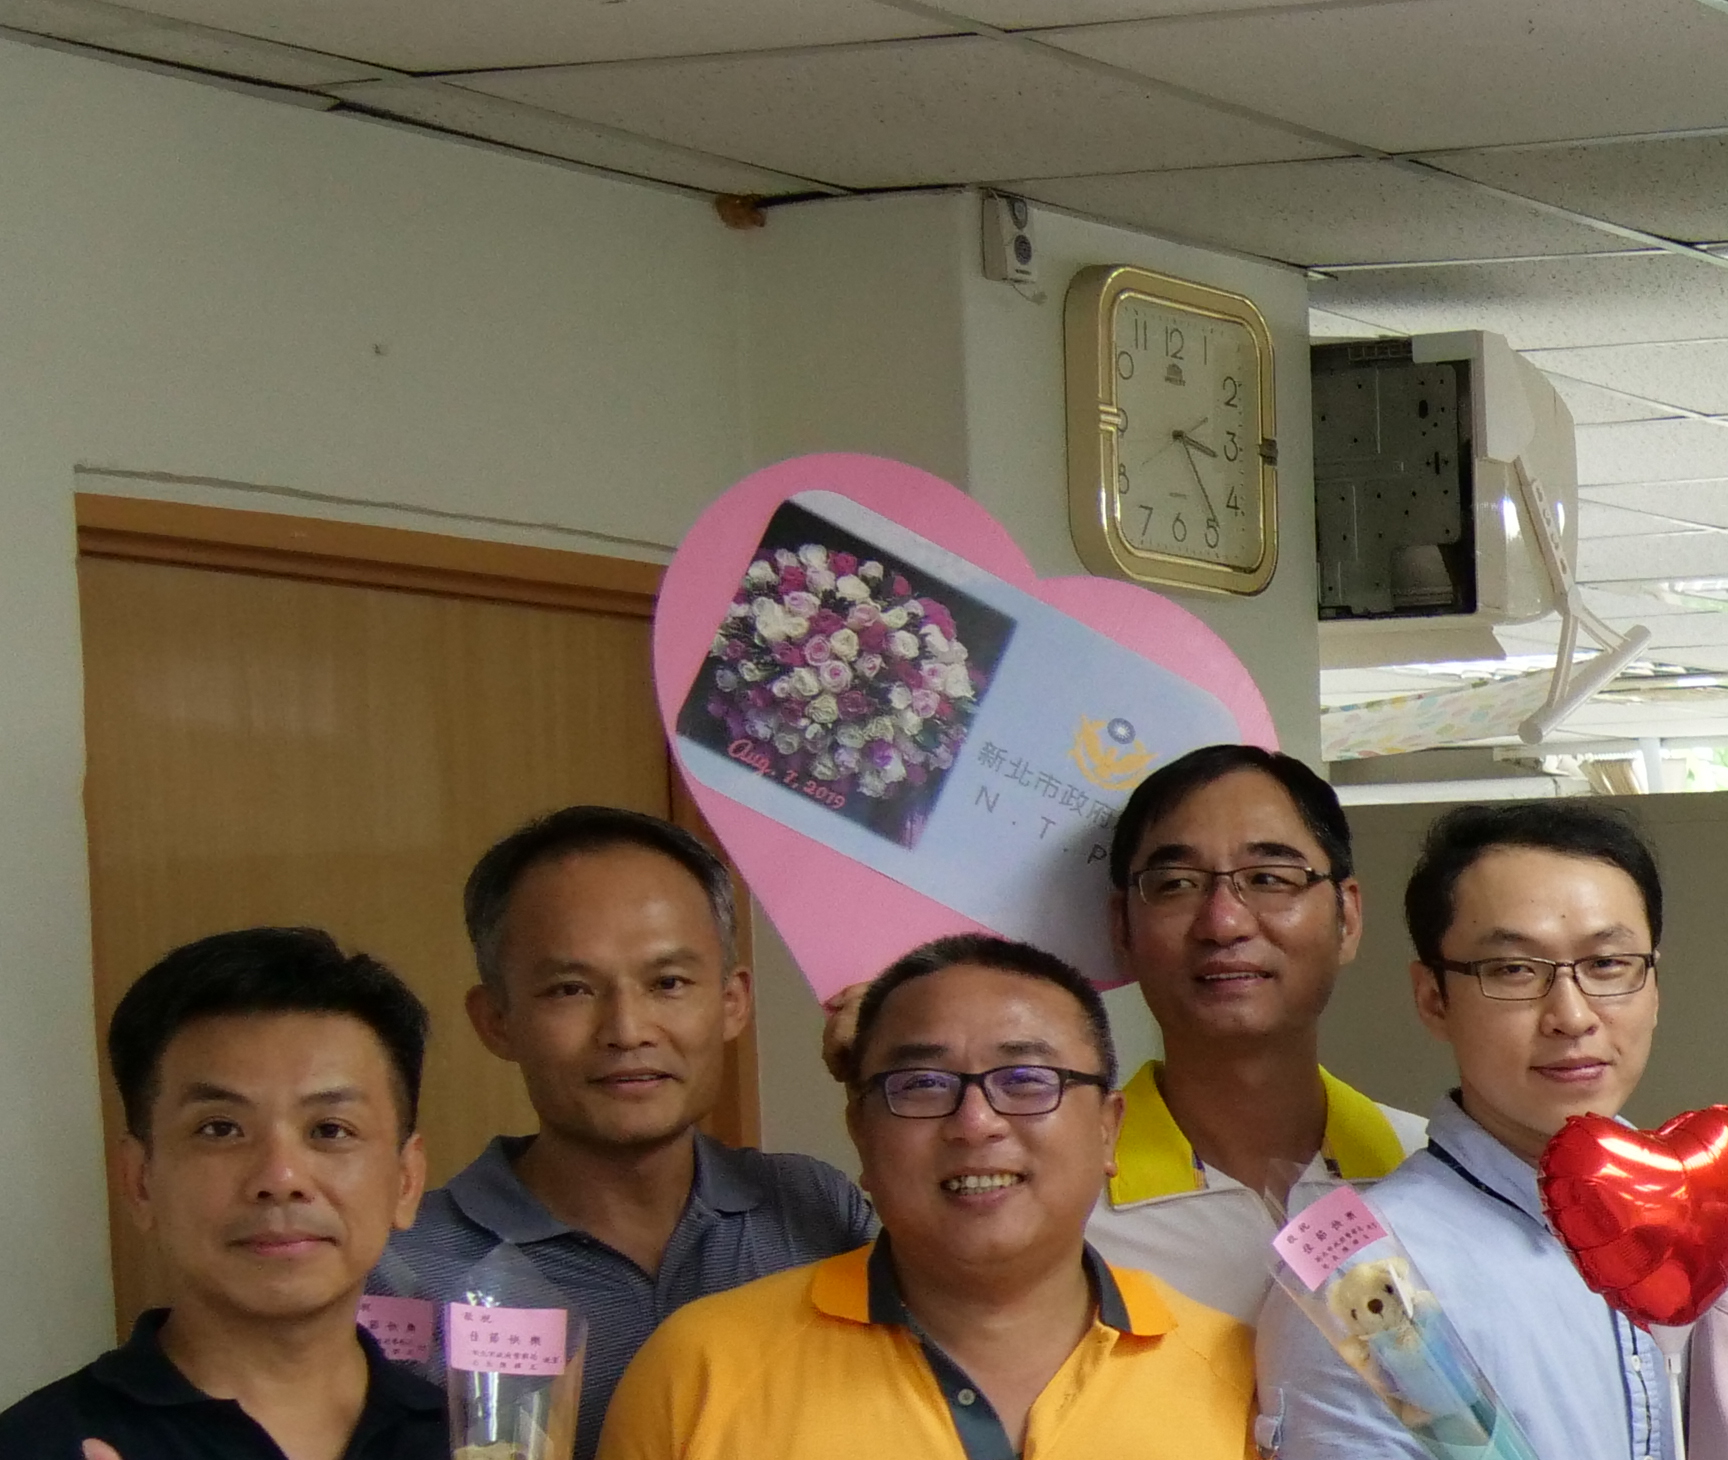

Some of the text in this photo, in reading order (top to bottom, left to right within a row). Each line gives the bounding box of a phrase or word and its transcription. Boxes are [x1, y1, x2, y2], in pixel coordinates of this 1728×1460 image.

[1165, 326, 1185, 361] 12
[1222, 376, 1238, 408] 2
[1223, 431, 1239, 462] 3
[1226, 485, 1240, 512] 4
[1139, 504, 1153, 537] 7
[1172, 511, 1187, 543] 6
[1204, 519, 1220, 549] 5
[977, 741, 1117, 829] 新北市政府
